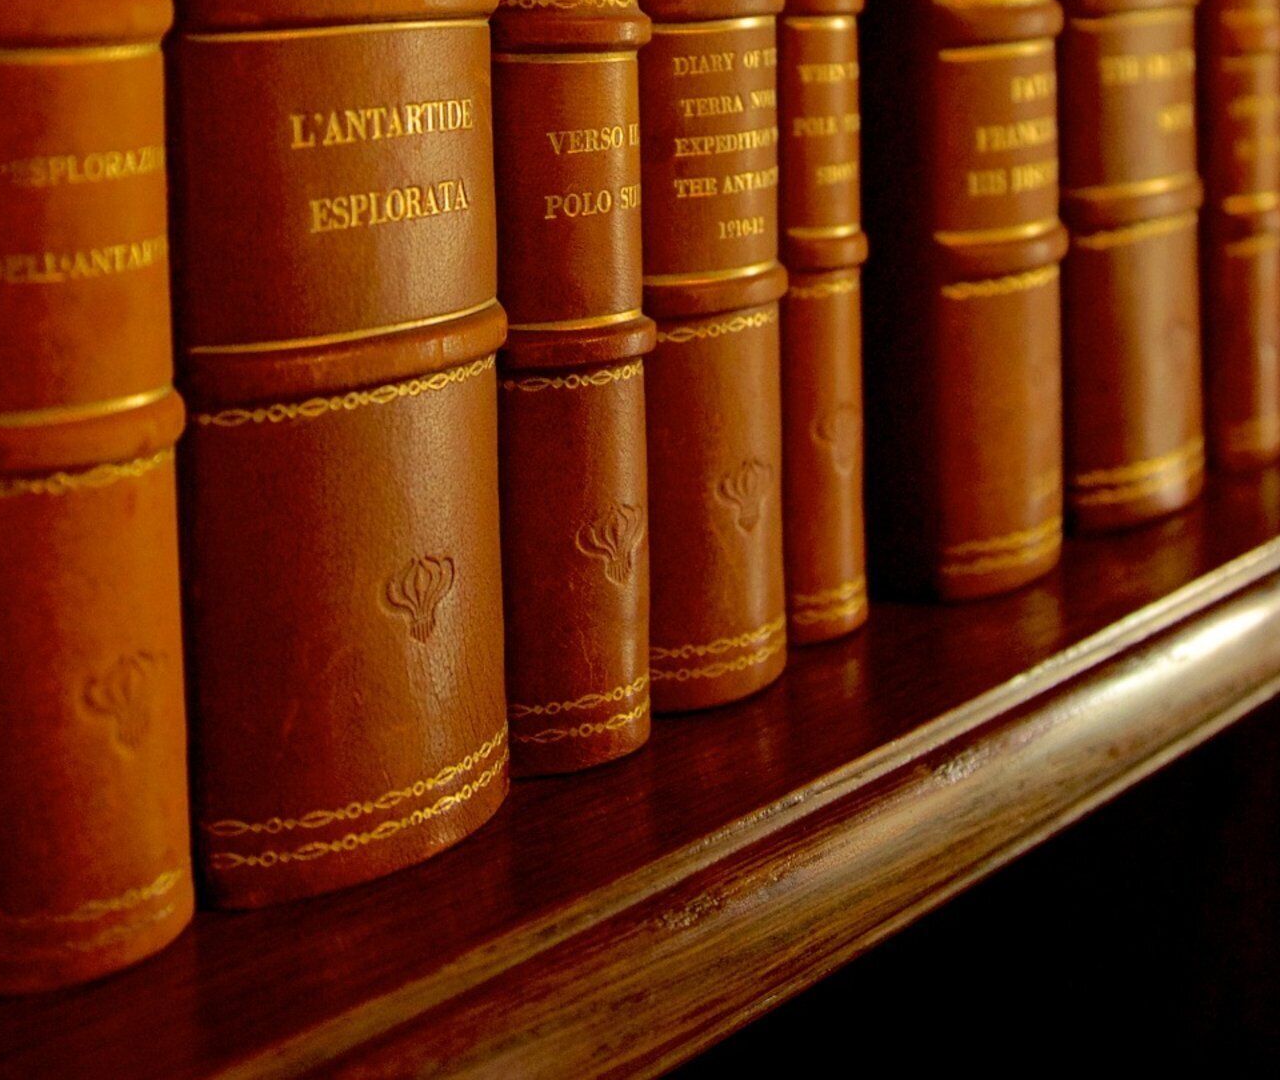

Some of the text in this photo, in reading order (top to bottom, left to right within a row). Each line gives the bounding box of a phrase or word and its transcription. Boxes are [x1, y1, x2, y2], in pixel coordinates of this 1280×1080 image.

[672, 51, 735, 76] DIARY
[680, 93, 744, 118] TERRA
[290, 98, 474, 150] L'ANTARTIDE
[546, 126, 624, 155] VERSO
[674, 177, 718, 198] THE
[308, 180, 470, 234] ESPLORATA
[544, 189, 612, 220] POLO
